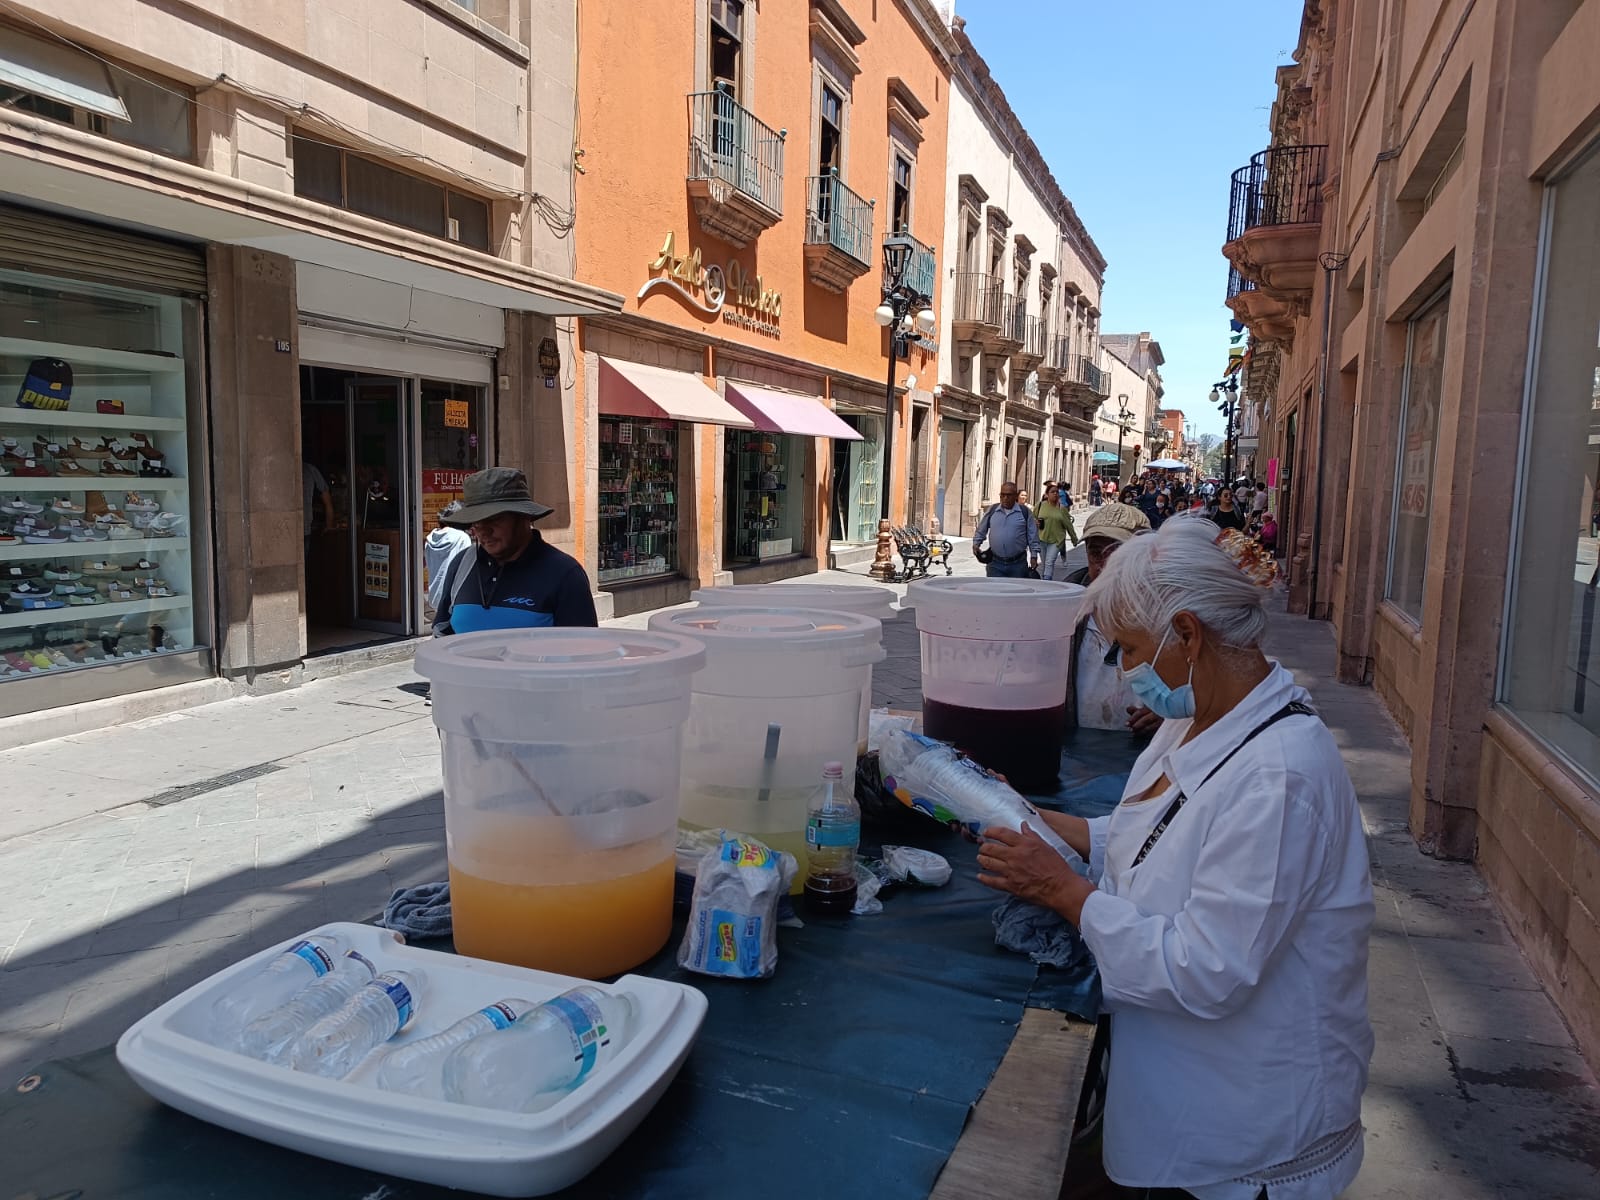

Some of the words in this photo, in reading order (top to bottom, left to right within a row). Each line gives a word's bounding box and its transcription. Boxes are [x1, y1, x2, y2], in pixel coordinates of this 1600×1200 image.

[277, 341, 290, 352] 105
[21, 389, 69, 410] PUMA
[434, 472, 448, 484] FU
[1137, 822, 1166, 863] BETTY
